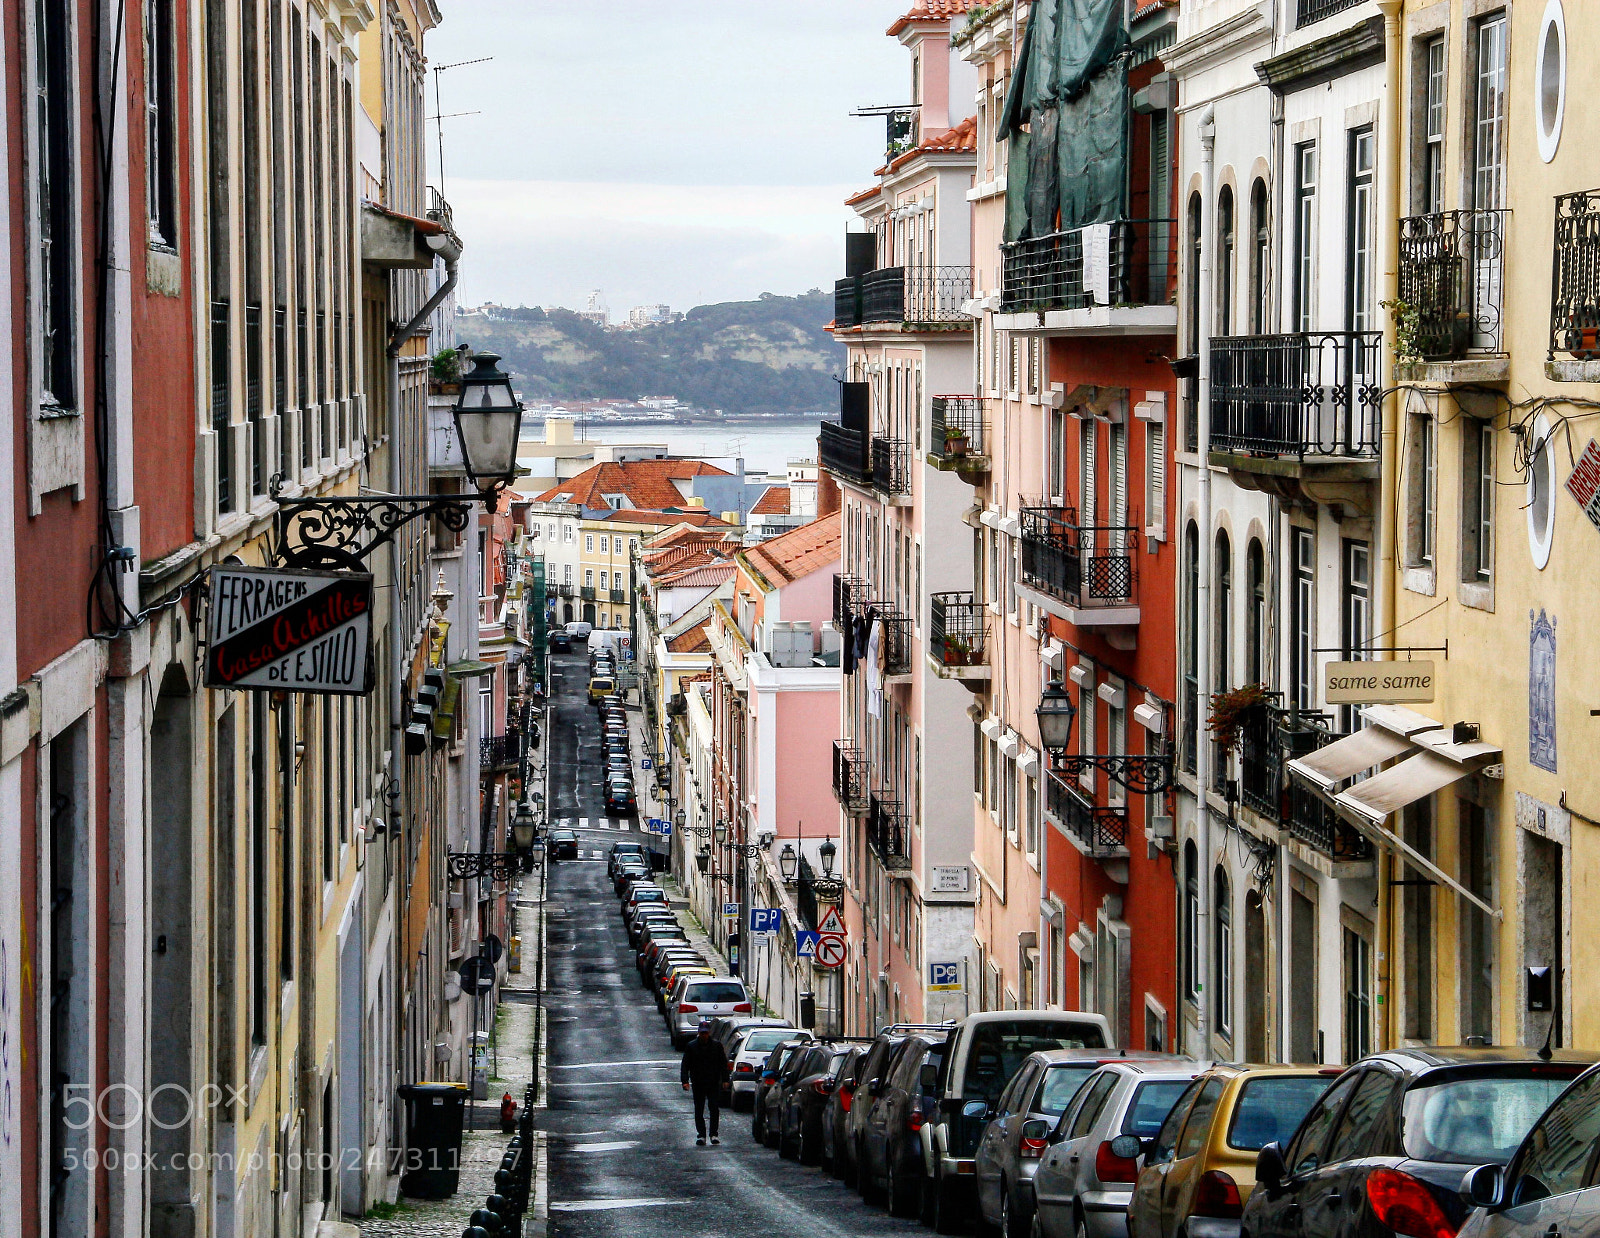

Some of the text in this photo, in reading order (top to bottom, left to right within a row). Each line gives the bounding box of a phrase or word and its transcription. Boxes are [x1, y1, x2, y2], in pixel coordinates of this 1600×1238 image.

[216, 575, 308, 640] FERRAGENS
[217, 592, 366, 681] Casa Achilles
[268, 625, 357, 685] DE ESTILO
[1328, 675, 1431, 689] same same
[755, 911, 768, 929] P
[770, 909, 778, 925] P
[933, 964, 947, 984] P
